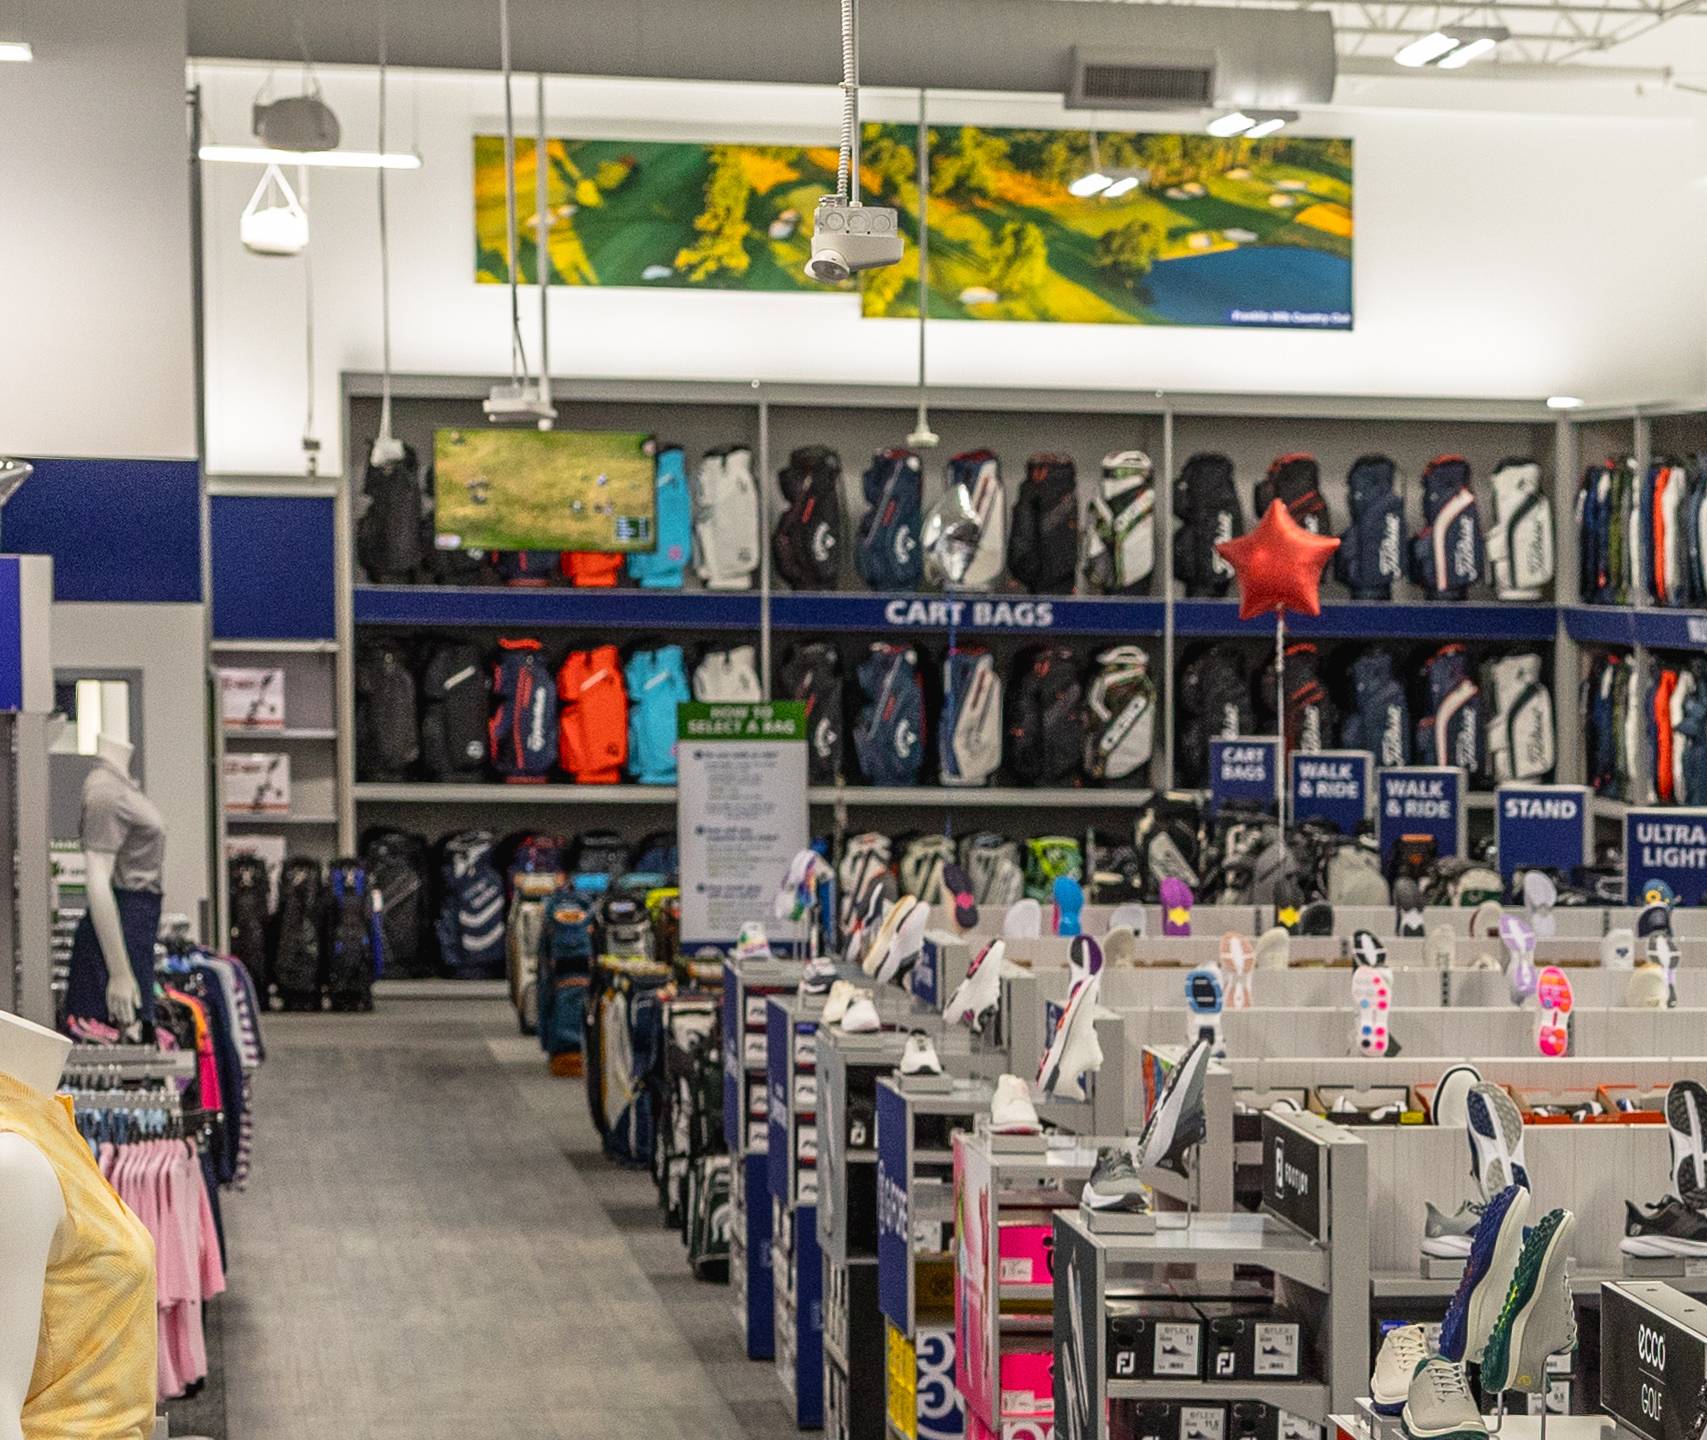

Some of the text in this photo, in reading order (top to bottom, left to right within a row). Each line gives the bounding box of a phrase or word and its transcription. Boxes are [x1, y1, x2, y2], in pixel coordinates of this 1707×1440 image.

[884, 600, 1054, 627] CART BAGS
[709, 705, 773, 719] HOW TO
[687, 719, 796, 735] SELECT A BAG
[1221, 746, 1265, 762] CART
[1221, 764, 1266, 780] BAGS
[1299, 763, 1353, 779] WALK
[1299, 781, 1359, 799] & RIDE
[1386, 780, 1443, 798] WALK
[1386, 799, 1451, 819] & RIDE
[1505, 798, 1578, 819] STAND
[1643, 847, 1707, 868] LIGHT
[1638, 1323, 1666, 1371] ecco
[1117, 1351, 1135, 1374] FJ
[1216, 1352, 1235, 1374] FJ
[1641, 1383, 1663, 1421] GOLF
